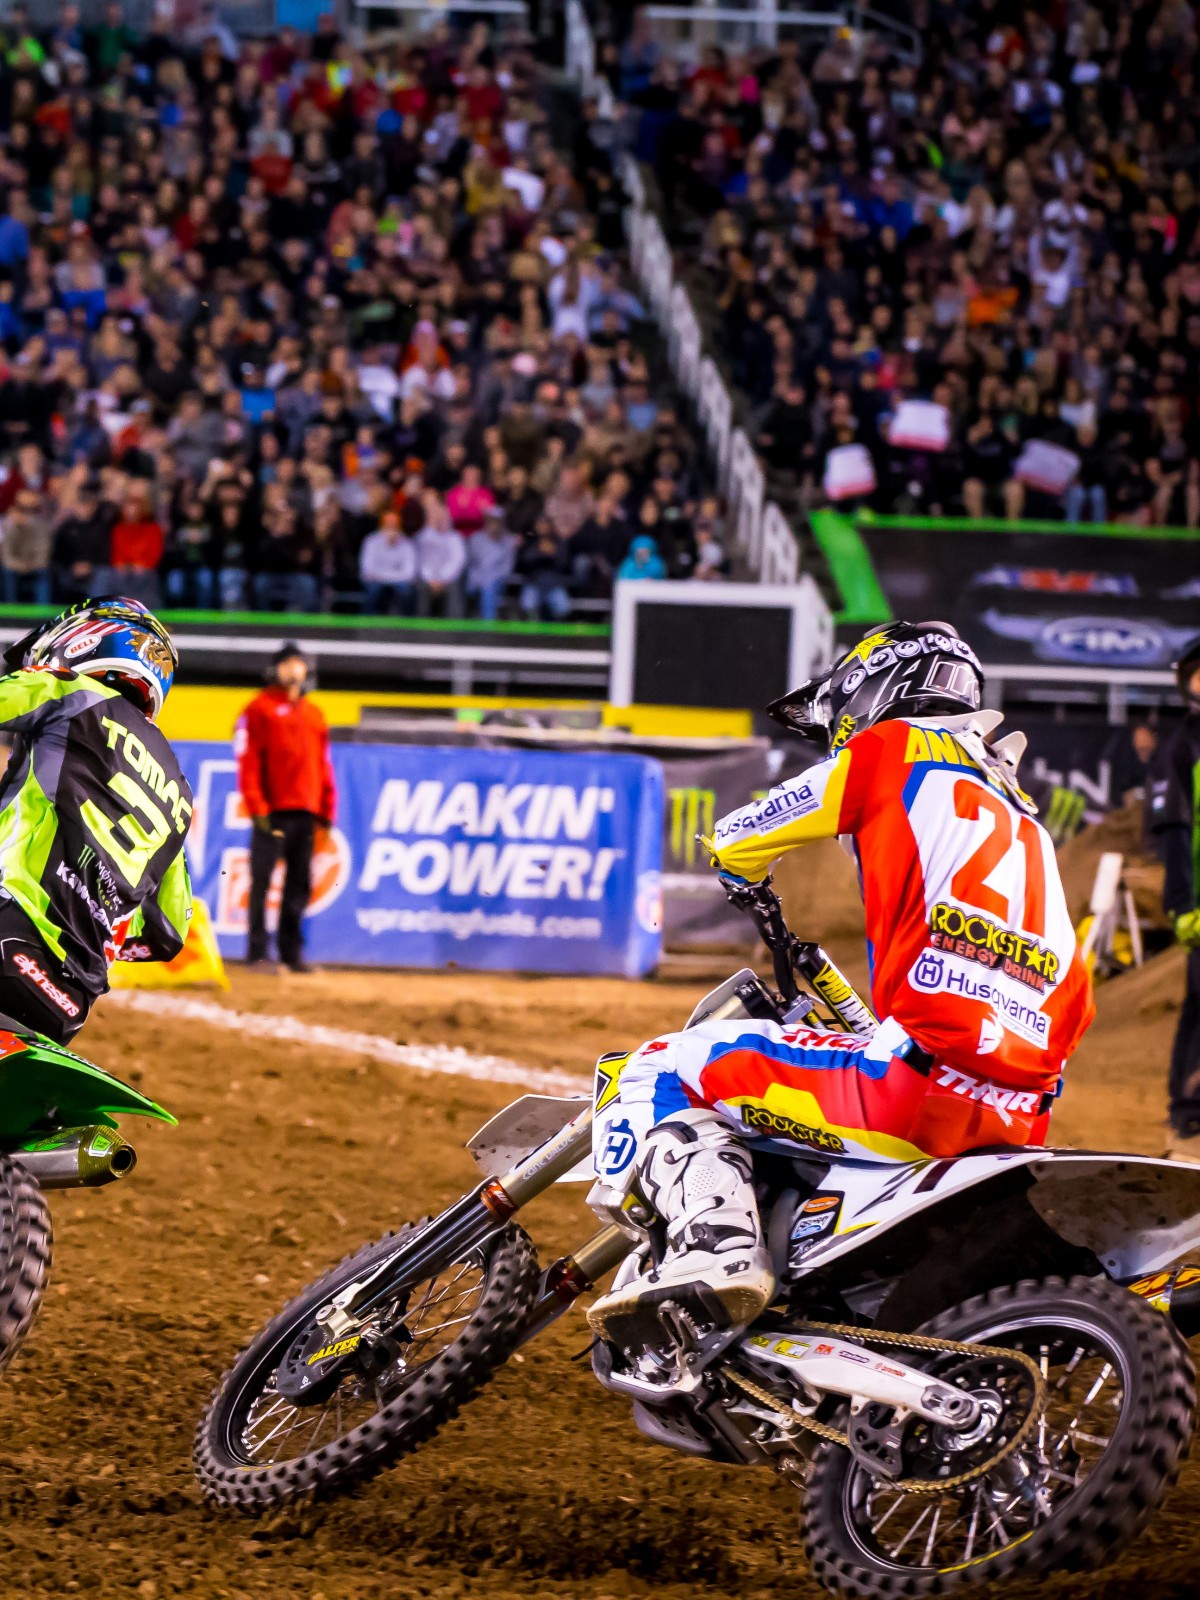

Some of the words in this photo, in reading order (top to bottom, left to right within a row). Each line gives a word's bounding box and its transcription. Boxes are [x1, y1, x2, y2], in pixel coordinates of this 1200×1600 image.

[70, 638, 95, 654] BELL
[101, 715, 192, 835] TOMAC
[371, 778, 615, 841] MAKIN'
[358, 838, 616, 901] POWER!
[951, 778, 1046, 939] 21
[933, 933, 999, 968] ENERGY
[1004, 959, 1048, 992] DRINK
[946, 969, 1048, 1035] Husqvarna
[935, 1064, 1040, 1114] THOR
